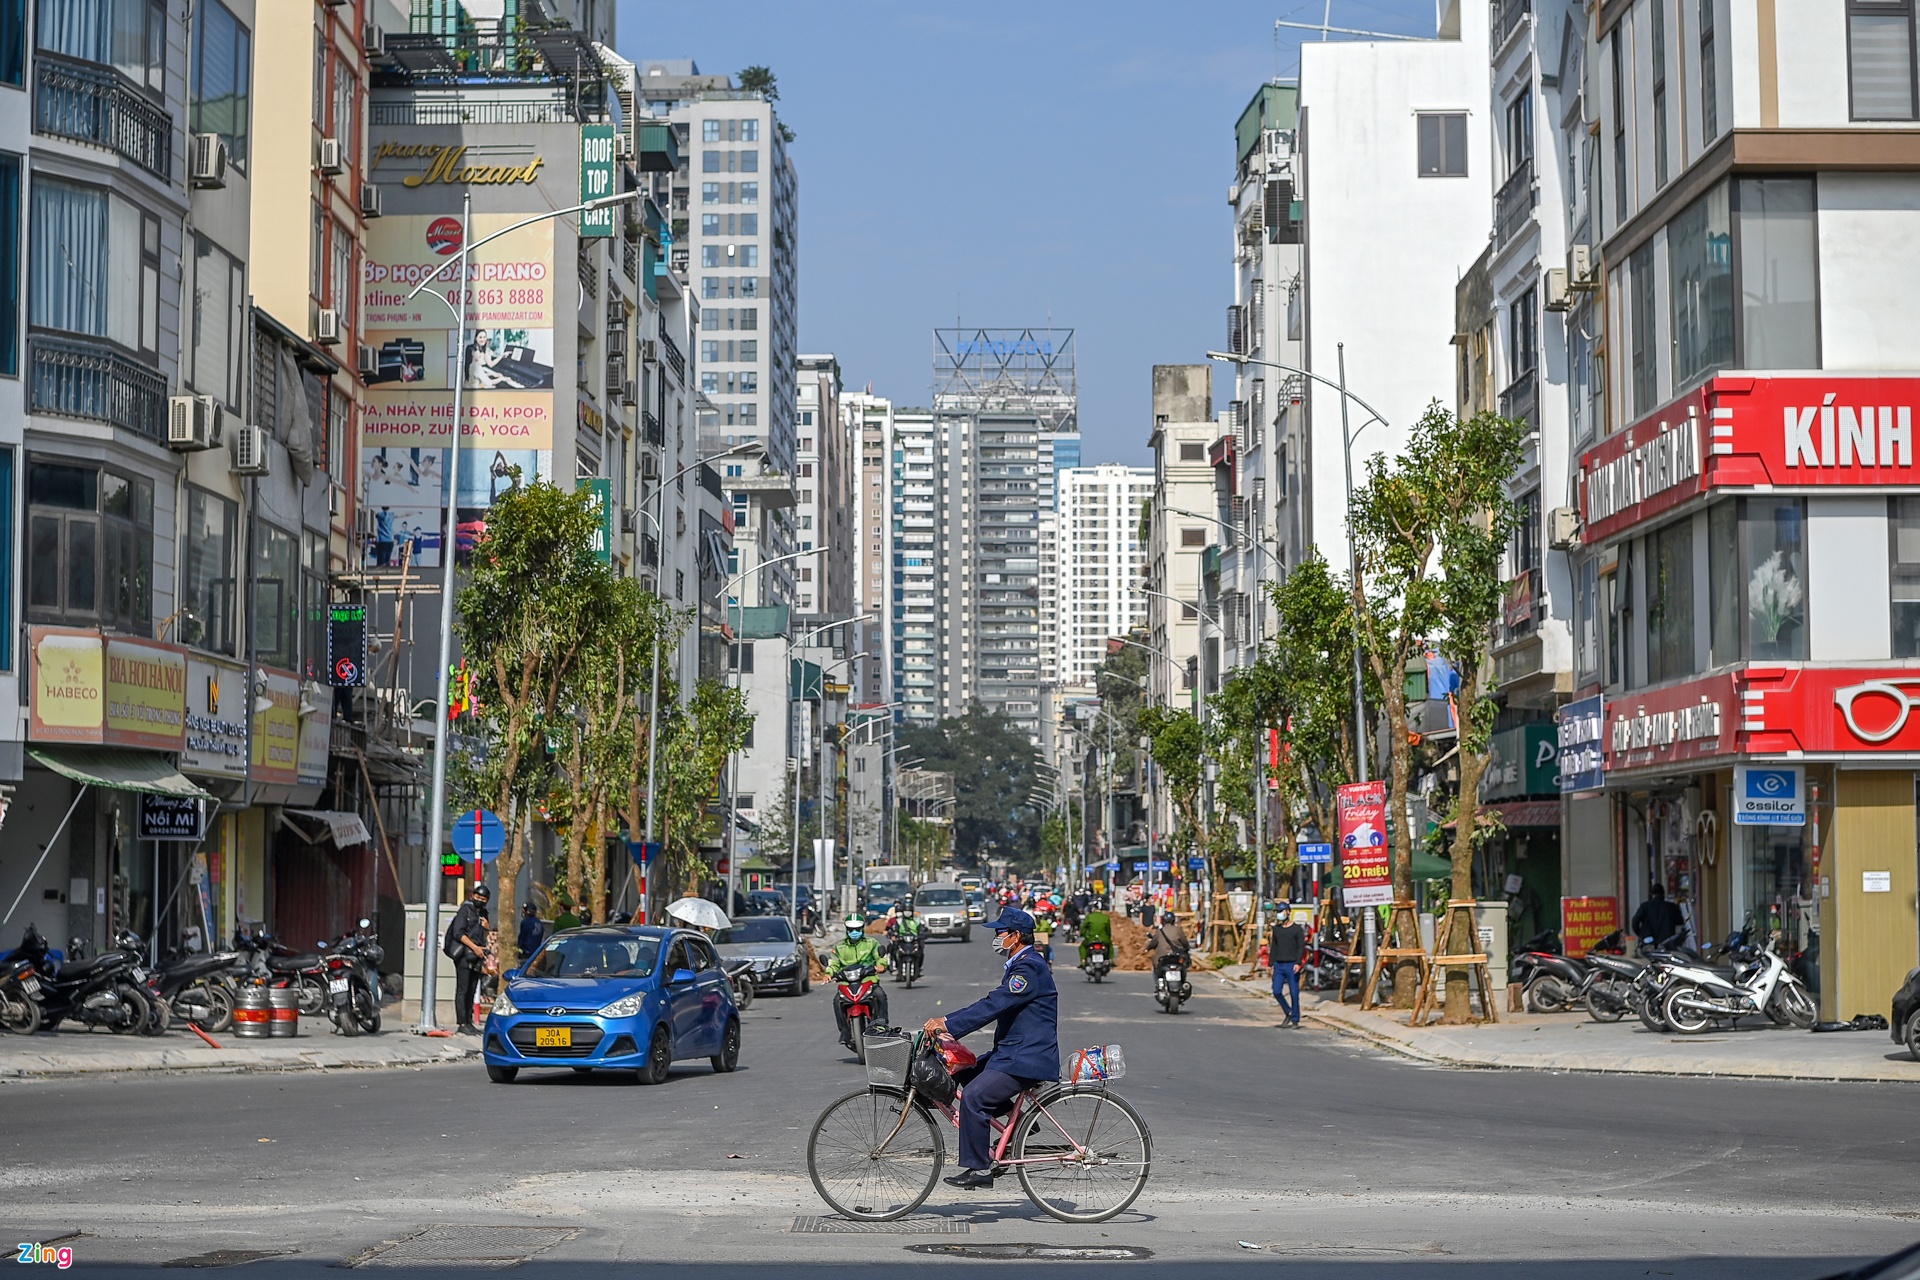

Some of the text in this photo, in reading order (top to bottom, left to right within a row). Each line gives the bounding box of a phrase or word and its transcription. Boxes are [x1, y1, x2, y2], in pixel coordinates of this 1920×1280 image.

[371, 141, 440, 171] piano
[584, 137, 612, 163] ROOF
[403, 146, 544, 189] Mozart
[587, 169, 608, 194] TOP
[365, 261, 388, 283] ỚP
[484, 262, 546, 282] PIANO
[364, 290, 406, 306] otline:
[478, 289, 503, 305] 863
[509, 289, 544, 304] 8888
[431, 403, 464, 420] HIỆ
[503, 408, 547, 420] KPOP,
[365, 423, 530, 437] HIPHOP, ZUBA, YOGA
[1784, 392, 1912, 467] KÍNH
[110, 656, 126, 684] BIA
[149, 658, 164, 690] HÀ
[165, 662, 182, 699] NỘI
[46, 686, 98, 700] HABECO
[1341, 793, 1382, 808] BLACK
[1746, 801, 1795, 811] essilor
[175, 813, 194, 826] Mi
[1344, 806, 1380, 821] Friday
[1343, 865, 1360, 878] 20
[1567, 911, 1592, 922] VÀNG
[546, 1029, 560, 1037] 30A
[540, 1038, 567, 1046] 209.16
